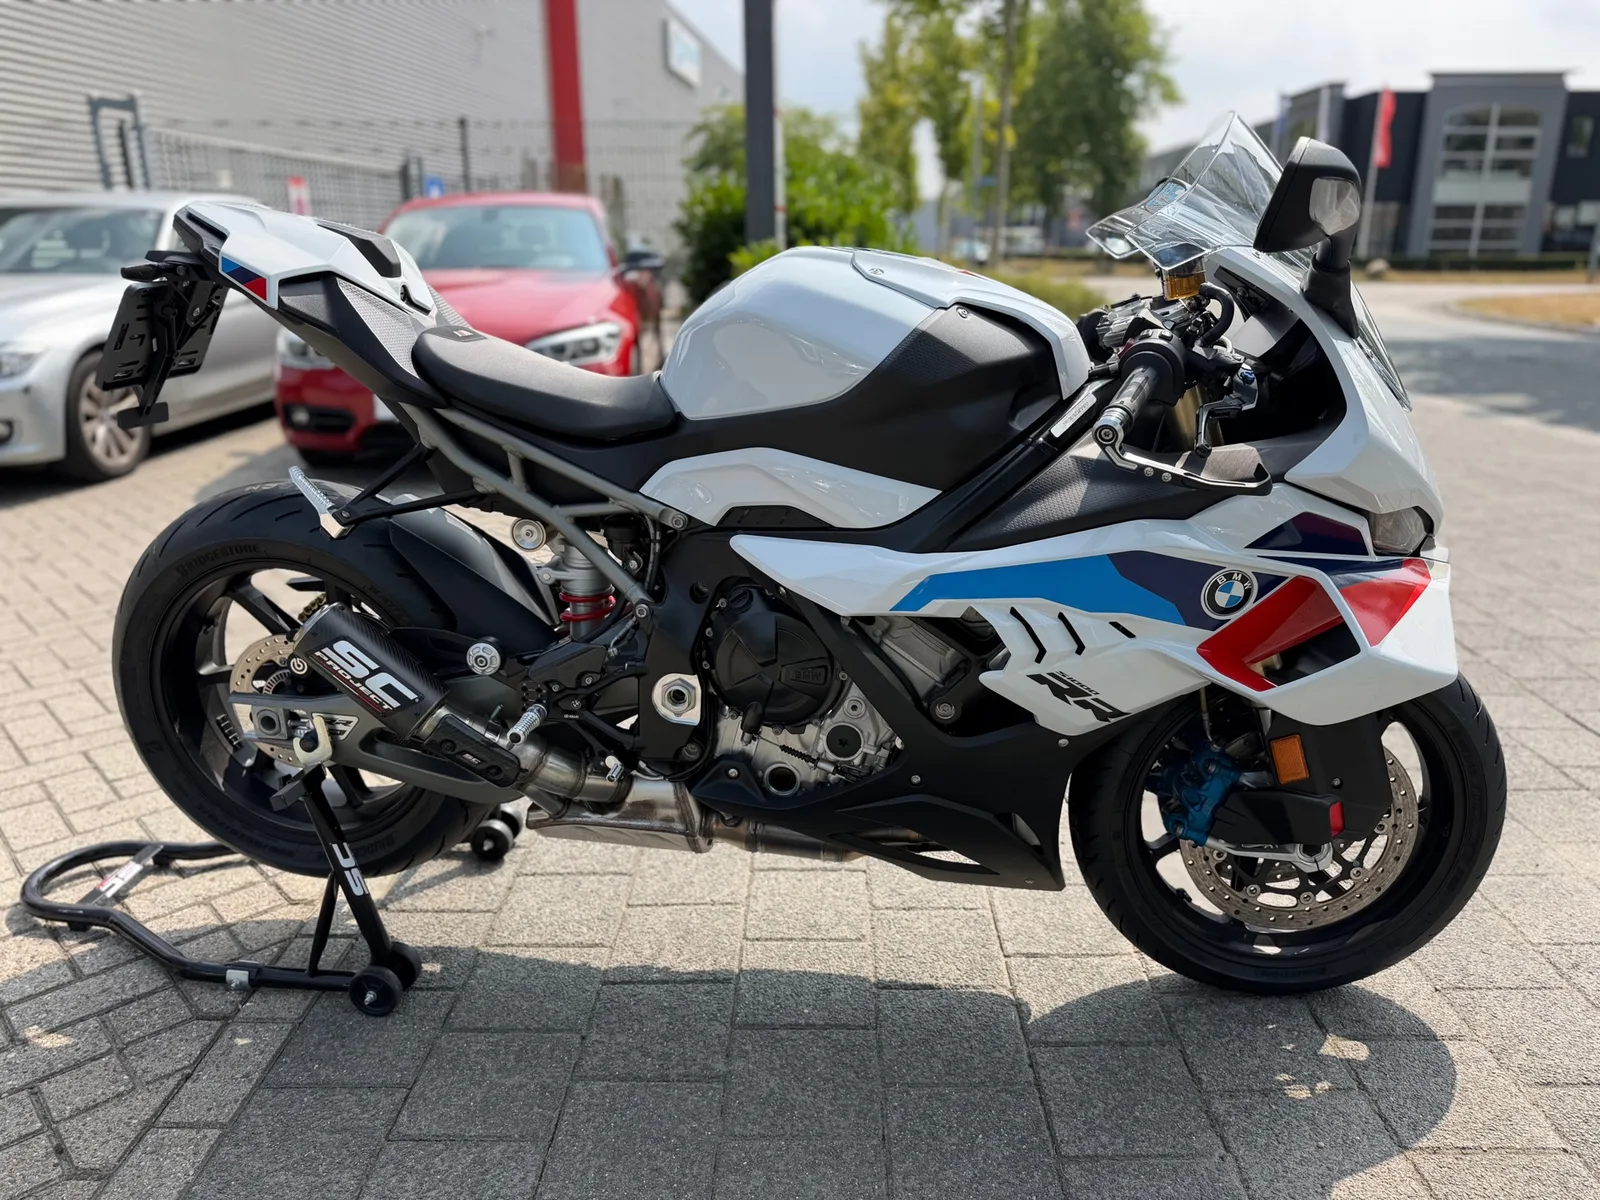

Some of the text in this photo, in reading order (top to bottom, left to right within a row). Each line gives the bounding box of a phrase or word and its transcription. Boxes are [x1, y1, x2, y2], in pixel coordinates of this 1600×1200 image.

[1216, 572, 1252, 590] BMW
[314, 651, 393, 711] PROJECT
[323, 640, 417, 709] SC
[795, 670, 821, 681] BMW
[331, 842, 369, 896] SC
